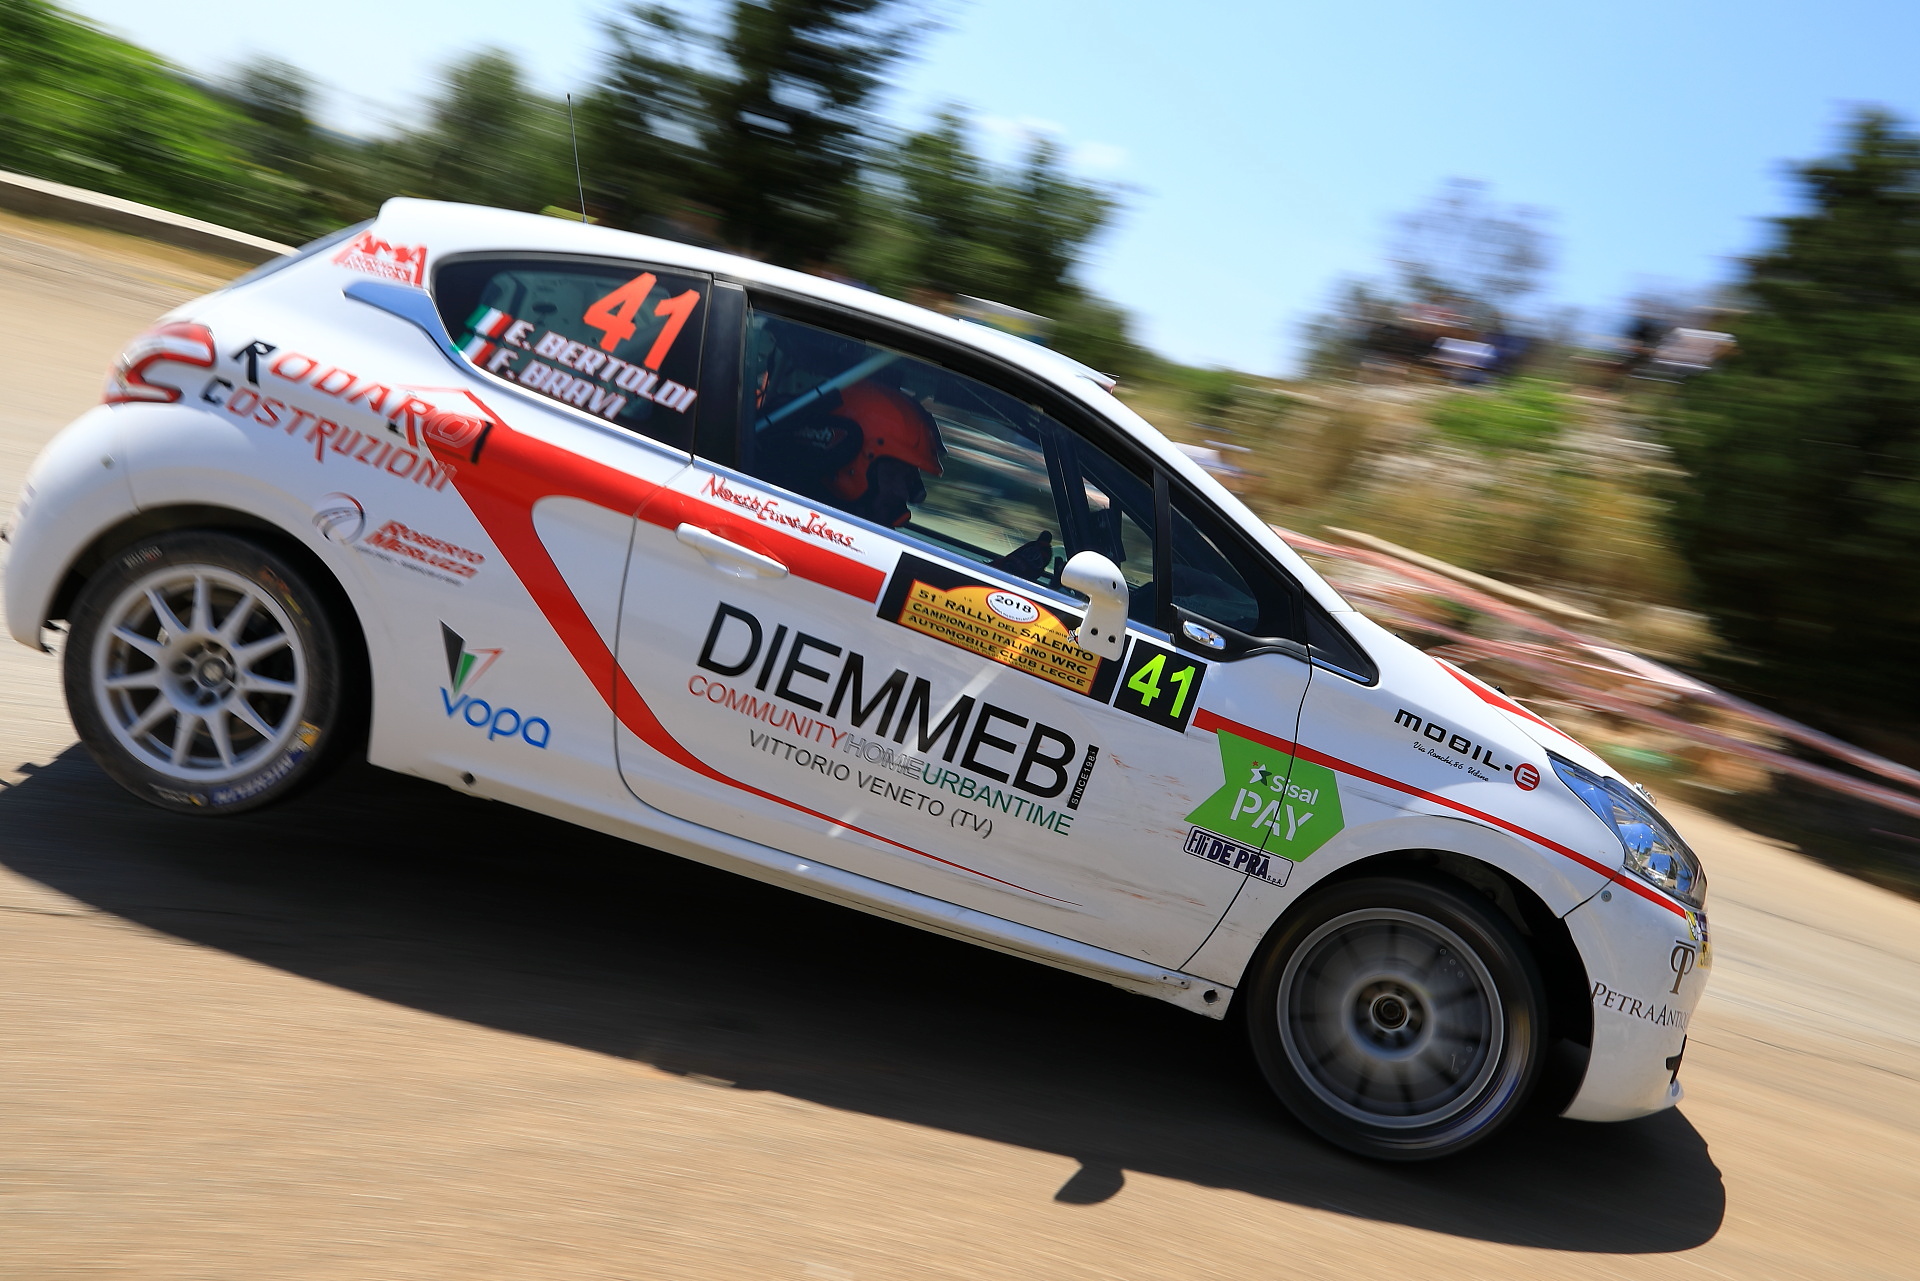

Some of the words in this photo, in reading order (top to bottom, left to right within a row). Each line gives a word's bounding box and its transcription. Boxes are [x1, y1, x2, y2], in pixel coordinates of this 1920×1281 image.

[583, 271, 701, 371] 41
[503, 319, 536, 351] E.
[533, 330, 698, 414] BERTOLDI
[517, 358, 628, 421] BRAVI
[944, 599, 996, 624] RALLY
[997, 620, 1018, 635] DEL
[1020, 628, 1095, 661] SALENTO
[995, 594, 1032, 614] 2018
[908, 615, 997, 653] AUTOMOBILE
[1000, 648, 1037, 668] CLUB
[1040, 664, 1086, 687] LECCE
[912, 602, 989, 637] CAMPIONATO
[992, 632, 1047, 659] ITALIANO
[1051, 653, 1088, 675] WRC
[1127, 652, 1196, 719] 41
[748, 728, 851, 782] VITTORIO
[856, 773, 945, 817] VENETO
[949, 807, 994, 840] (TV)
[1269, 775, 1319, 806] Sisal
[1467, 766, 1489, 782] Udine
[1229, 787, 1314, 842] PAY
[1207, 840, 1236, 866] DE
[1233, 849, 1271, 880] PRA
